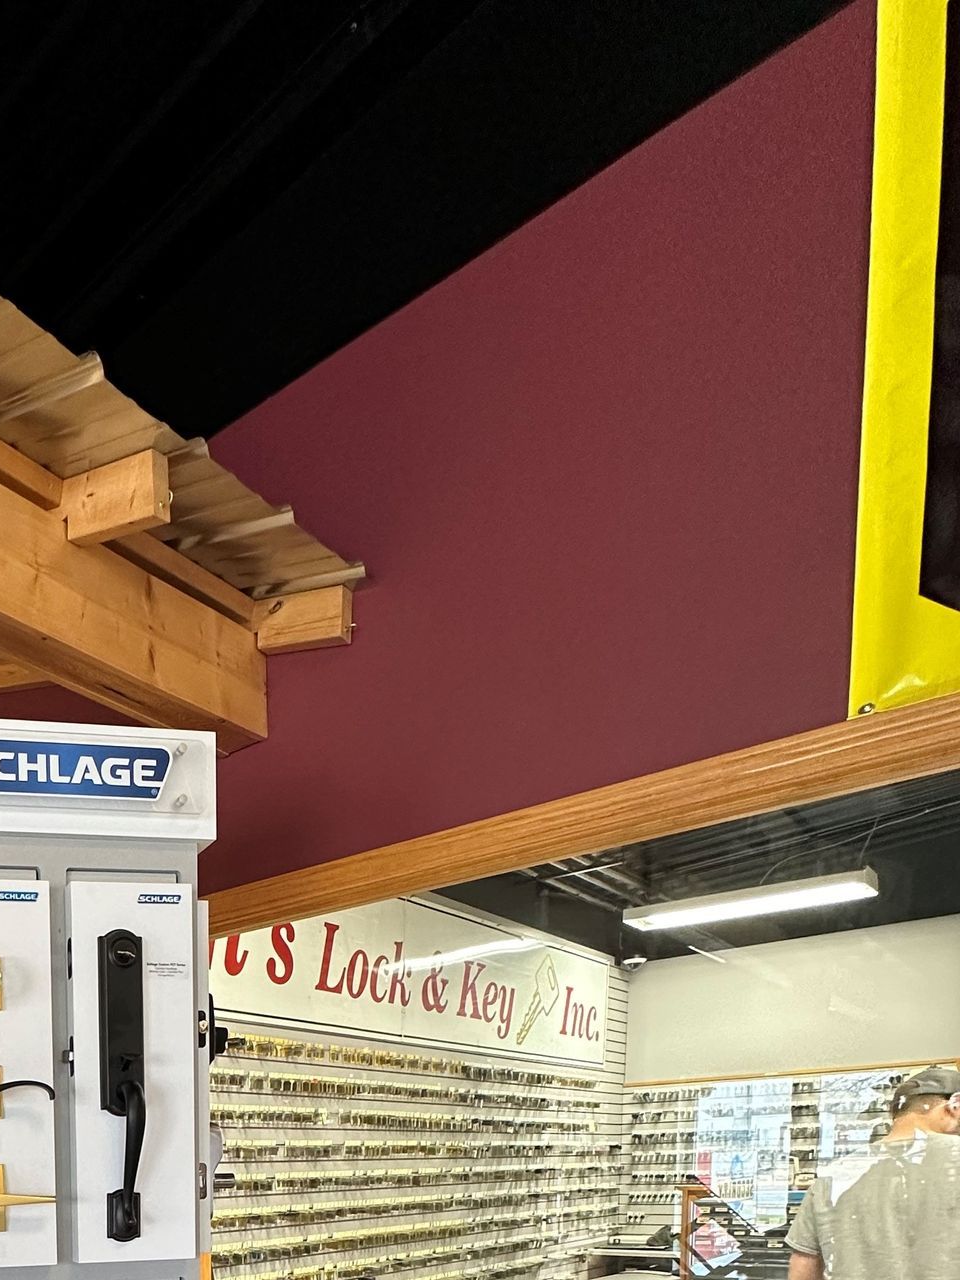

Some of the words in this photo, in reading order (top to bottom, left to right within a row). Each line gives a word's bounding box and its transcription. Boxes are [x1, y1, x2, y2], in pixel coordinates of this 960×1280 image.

[138, 894, 181, 904] SCHLAGE
[315, 922, 411, 1008] Lock
[456, 960, 515, 1040] Key
[560, 986, 600, 1042] Inc.
